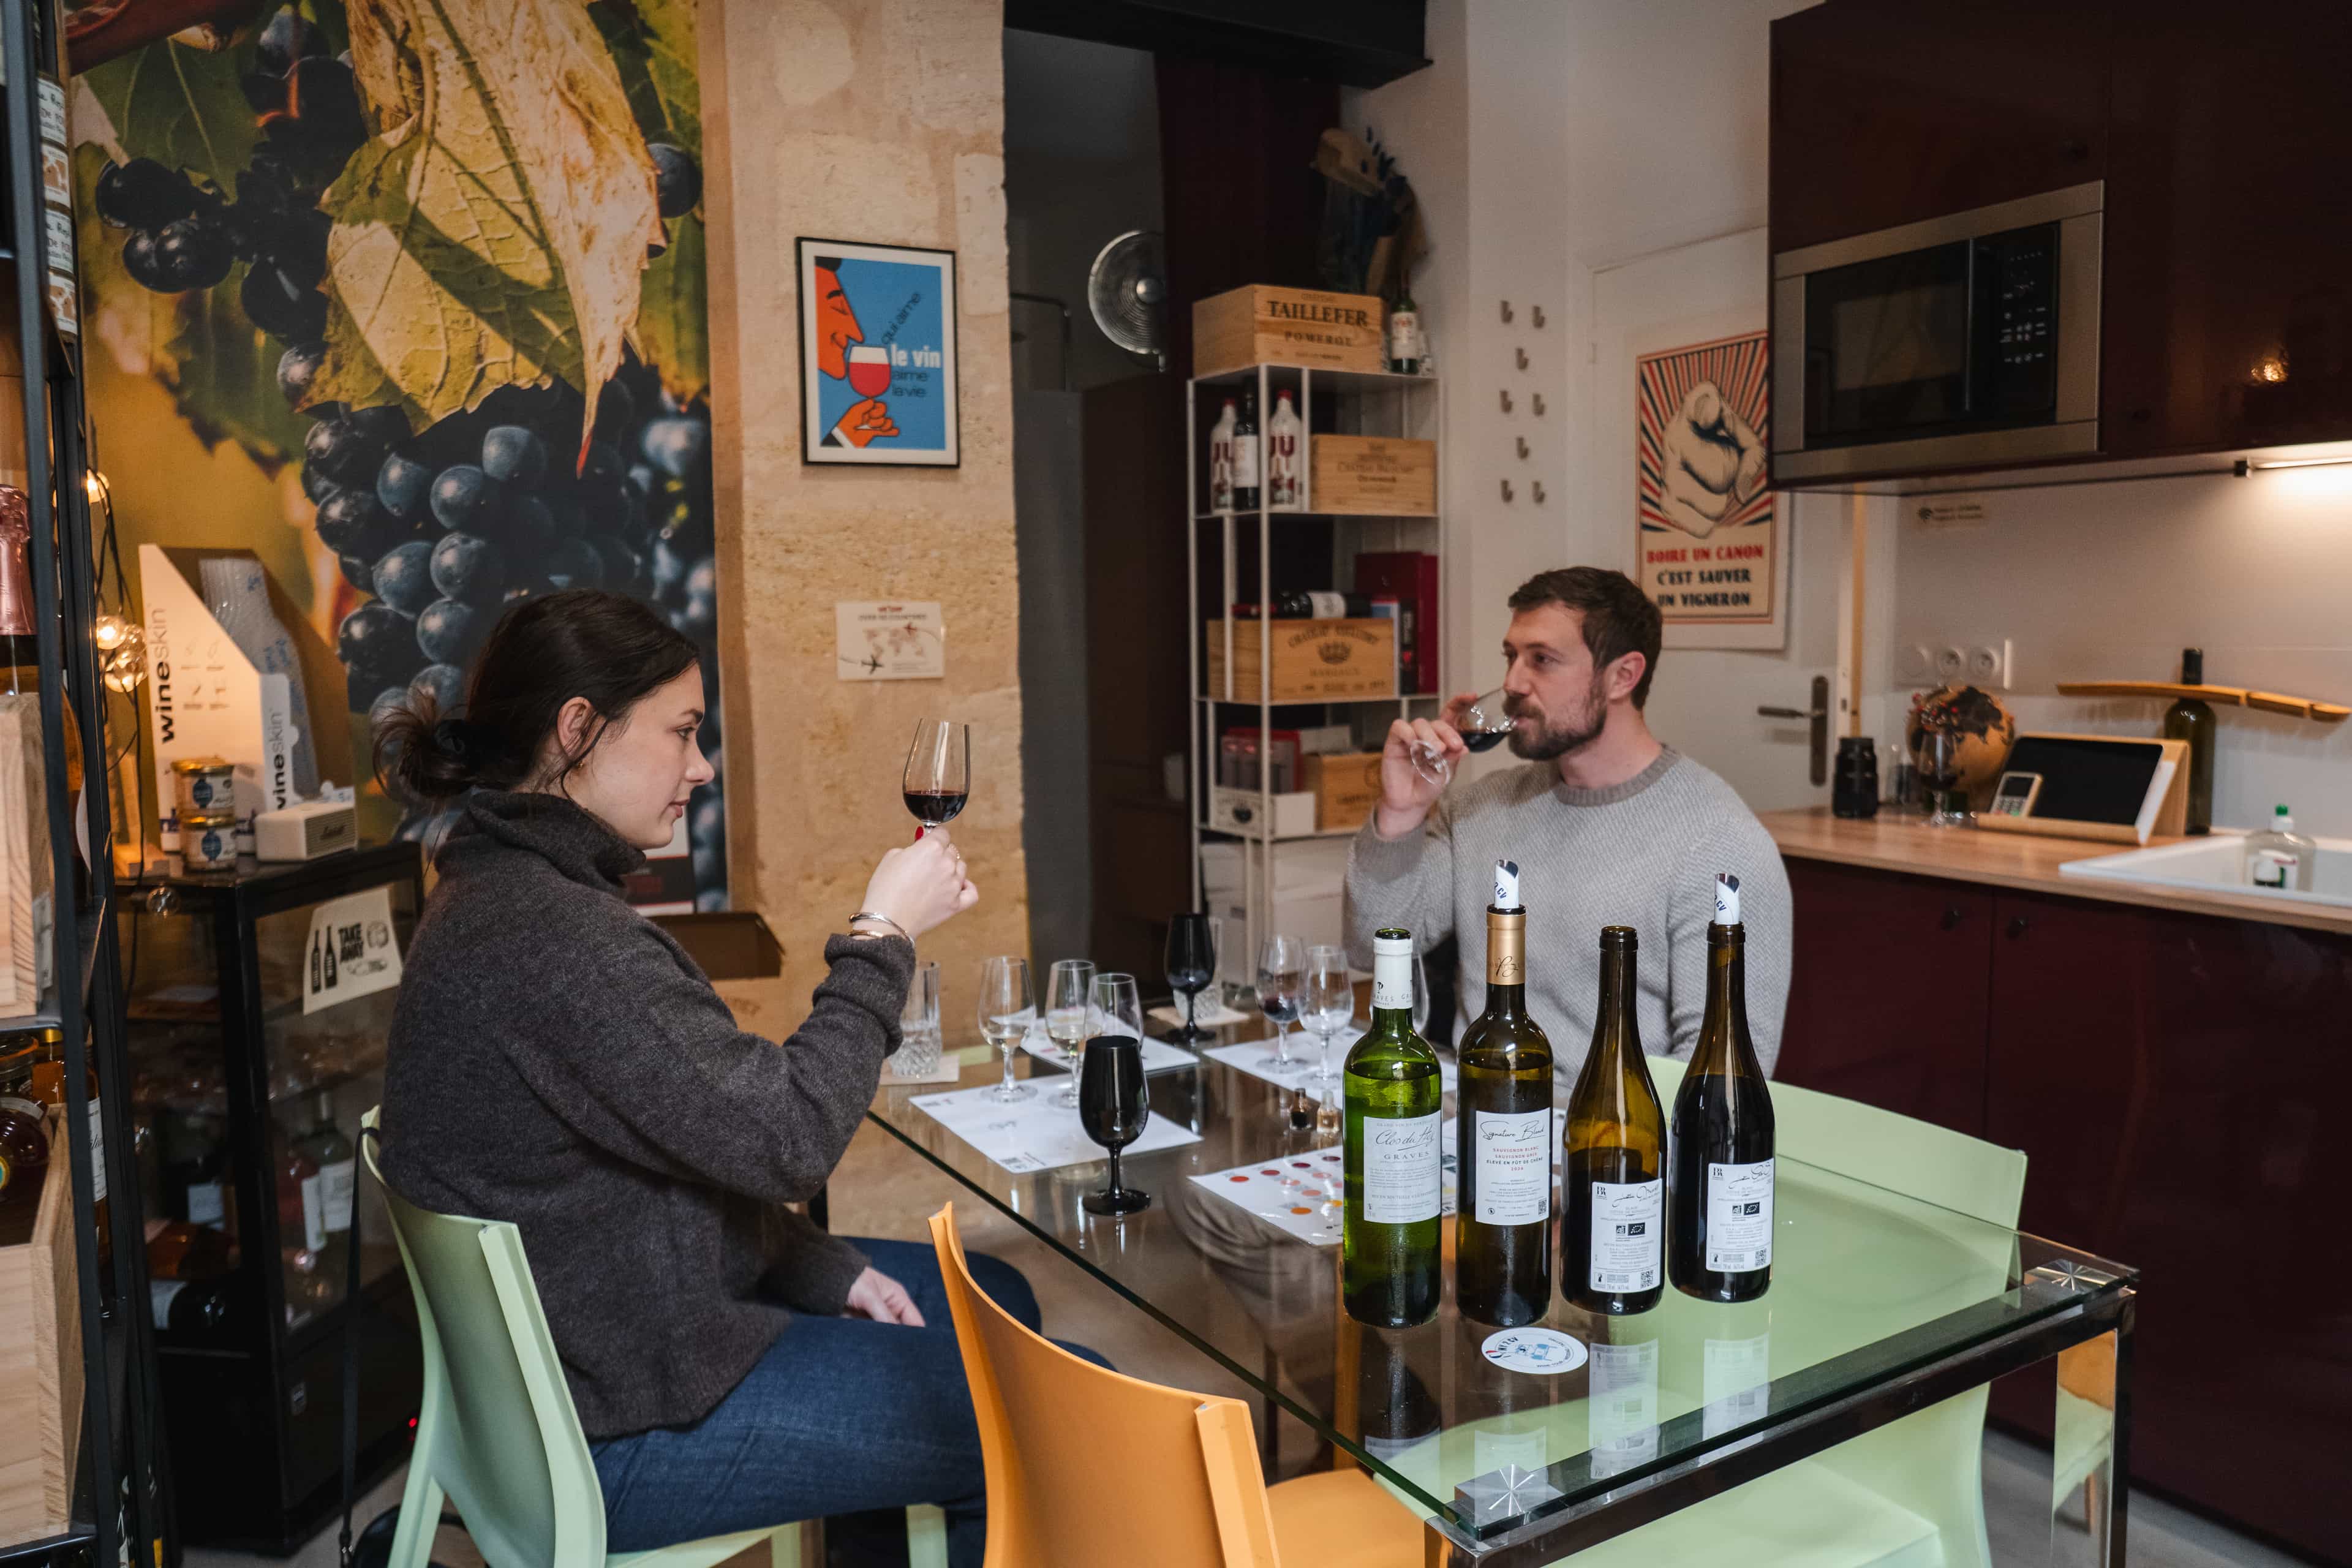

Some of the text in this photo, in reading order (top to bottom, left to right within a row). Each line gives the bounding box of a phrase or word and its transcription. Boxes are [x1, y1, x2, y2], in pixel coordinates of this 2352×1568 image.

[881, 292, 921, 345] qui aime
[1267, 300, 1368, 327] TAILLEFER
[1284, 330, 1352, 347] POMEROL
[891, 343, 941, 368] le vin
[891, 371, 929, 382] aime
[907, 386, 927, 398] vie
[1646, 544, 1764, 564] BOIRE UN CANON
[1657, 568, 1751, 586] C'EST SAUVER
[1657, 592, 1751, 606] UN VIGNERON
[149, 608, 175, 745] wineskin
[1497, 888, 1507, 899] CV
[1716, 900, 1727, 911] CV
[338, 922, 361, 945] TAKE
[1375, 1129, 1401, 1146] Clos
[1402, 1131, 1417, 1145] du
[1480, 1120, 1545, 1140] Signature Blend
[1384, 1152, 1430, 1160] GRAVES
